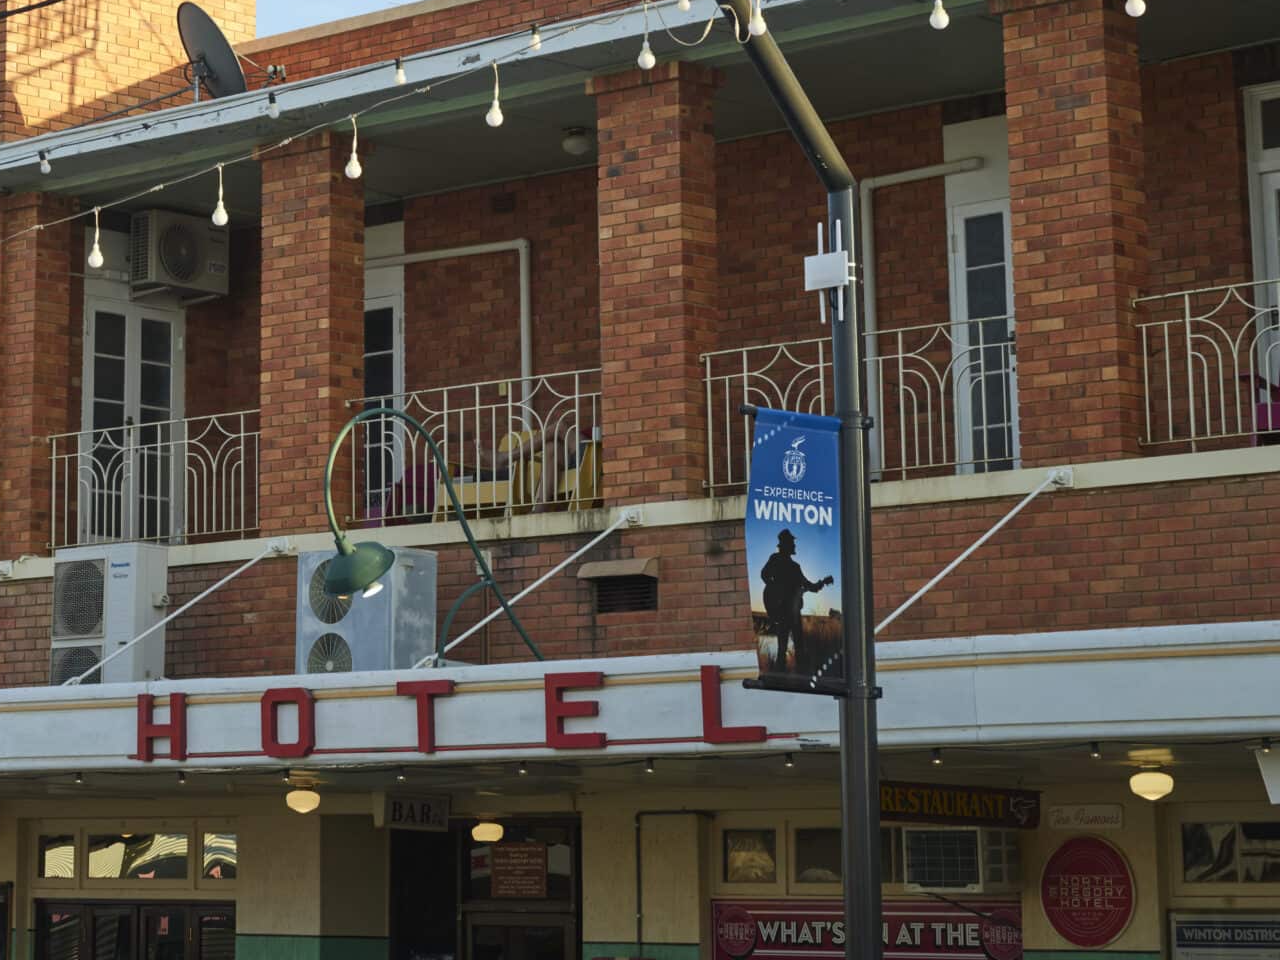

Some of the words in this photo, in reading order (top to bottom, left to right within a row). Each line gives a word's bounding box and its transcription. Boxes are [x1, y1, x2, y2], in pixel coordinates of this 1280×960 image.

[763, 486, 824, 502] EXPERIENCE
[754, 499, 833, 527] WINTON
[137, 665, 768, 762] HOTEL
[392, 800, 431, 823] BAR
[880, 784, 1008, 818] RESTAURANT
[1060, 876, 1113, 888] NORTH
[1060, 898, 1114, 908] HOTEL
[757, 920, 846, 944] WHAT'S
[895, 922, 925, 945] AT
[930, 923, 981, 946] THE
[1183, 928, 1232, 941] WINTON
